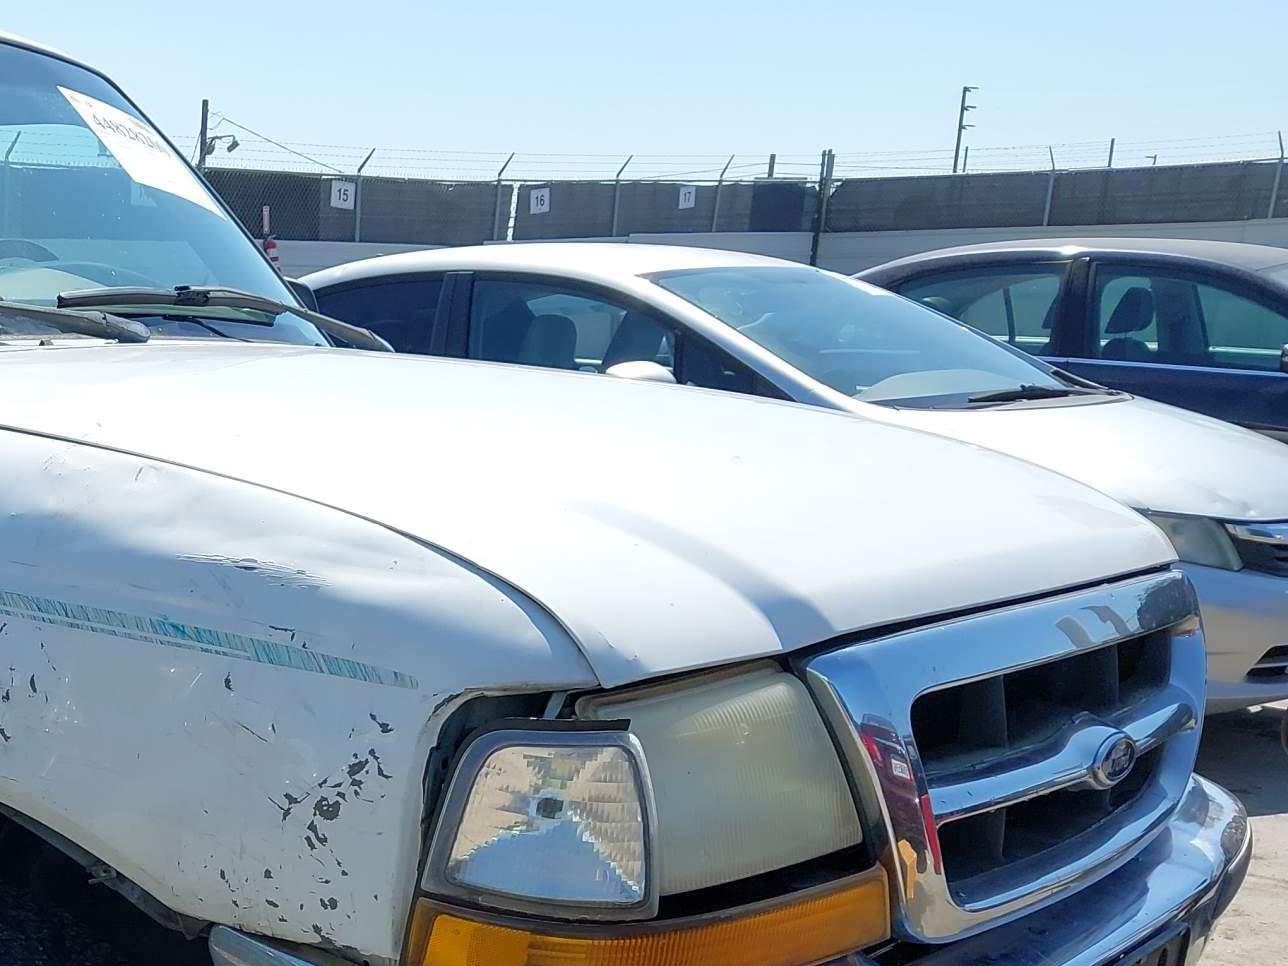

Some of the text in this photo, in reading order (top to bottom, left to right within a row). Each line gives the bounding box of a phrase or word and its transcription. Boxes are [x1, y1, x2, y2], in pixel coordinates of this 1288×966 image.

[336, 189, 350, 203] 15
[535, 194, 546, 208] 16
[683, 191, 692, 204] 17
